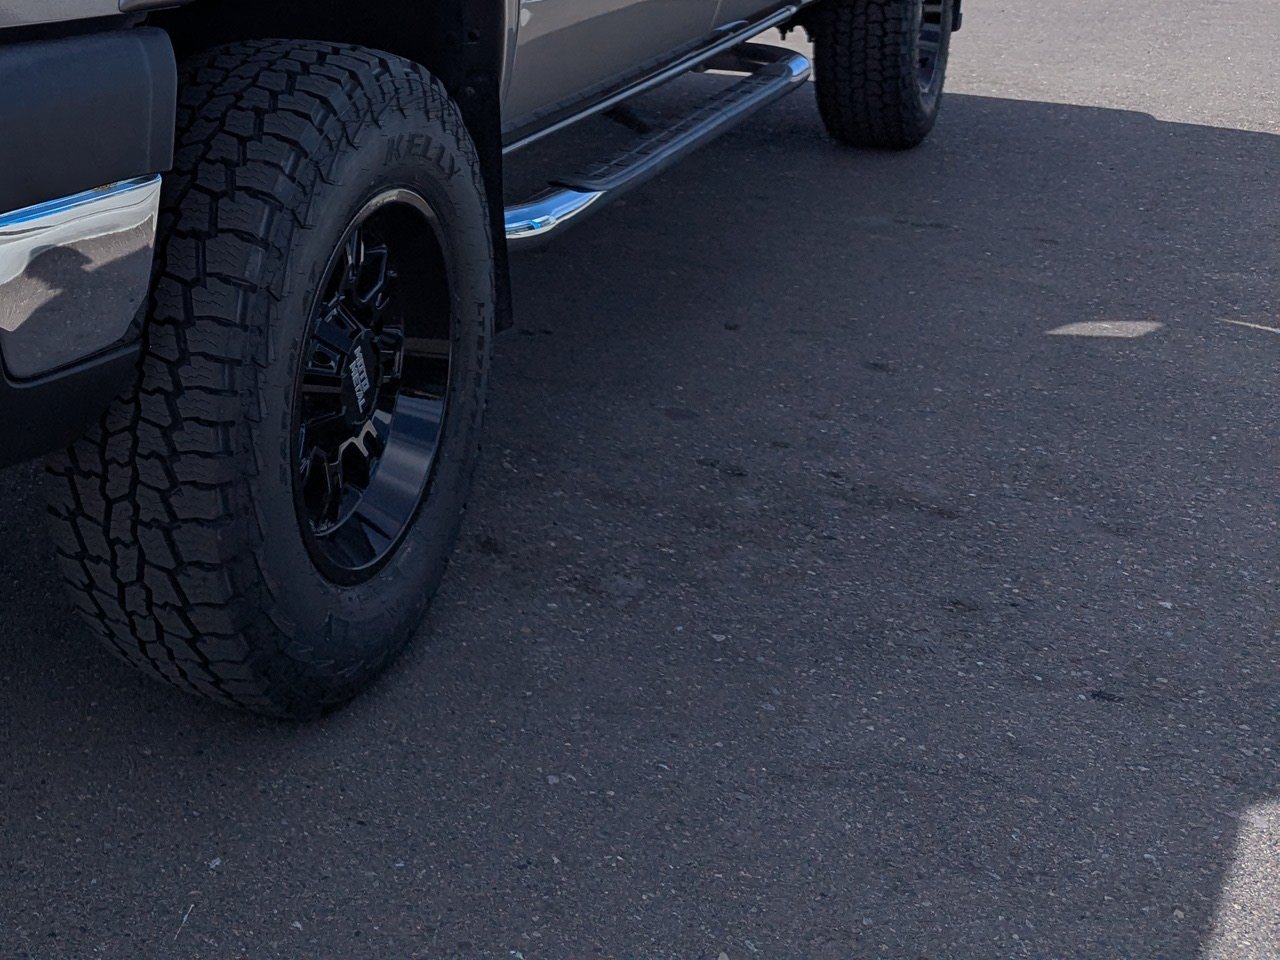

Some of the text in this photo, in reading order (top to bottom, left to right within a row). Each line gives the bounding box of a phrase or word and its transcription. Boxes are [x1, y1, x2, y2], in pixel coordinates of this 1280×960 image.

[383, 133, 461, 179] KELLY
[349, 359, 367, 413] METAL
[353, 345, 370, 393] MOTO
